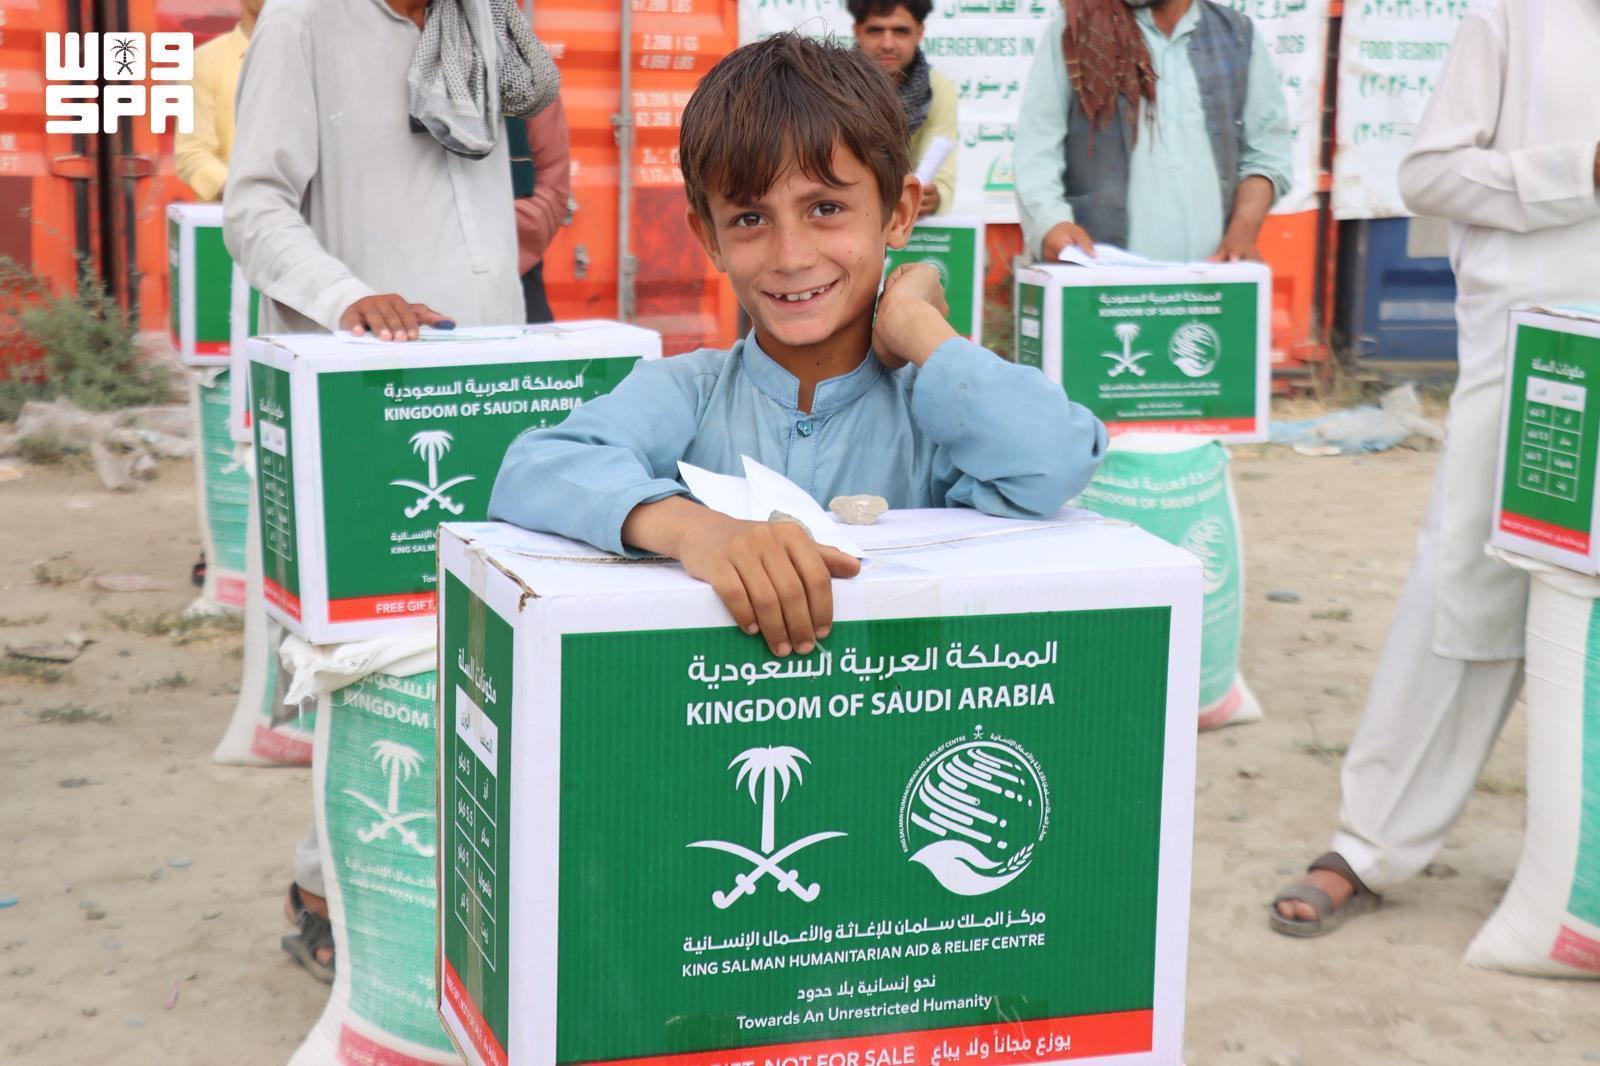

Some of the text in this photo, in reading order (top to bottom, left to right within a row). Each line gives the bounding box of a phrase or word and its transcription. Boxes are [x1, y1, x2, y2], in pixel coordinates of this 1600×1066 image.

[924, 37, 1017, 57] MERGENCIES
[1395, 40, 1448, 61] SECURIT
[383, 374, 584, 402] المملكة العربية السعودية
[383, 404, 458, 421] KINGDOM
[460, 403, 480, 417] OF
[483, 400, 528, 416] SAUDI
[412, 544, 437, 553] SALM
[375, 601, 406, 614] FREE
[688, 641, 1058, 690] المملكة العربية السعودية
[343, 688, 429, 729] KINGDOM
[686, 683, 1055, 726] KINGDOM OF SAUDI ARABIA
[683, 909, 1046, 955] مركز الملك سلمان للإغاثة والأعمال الإنسانية
[682, 933, 1046, 977] KING SALMAN HUMANITARIAN AID & RELIEF CENTRE
[796, 974, 936, 1002] نحو إنسانية بلا حدود
[736, 993, 993, 1030] Towards An Unrestricted Humanity
[864, 1045, 916, 1066] SALE
[930, 1040, 961, 1066] يباع
[965, 1036, 990, 1060] ولا
[1035, 1032, 1071, 1056] يوزع
